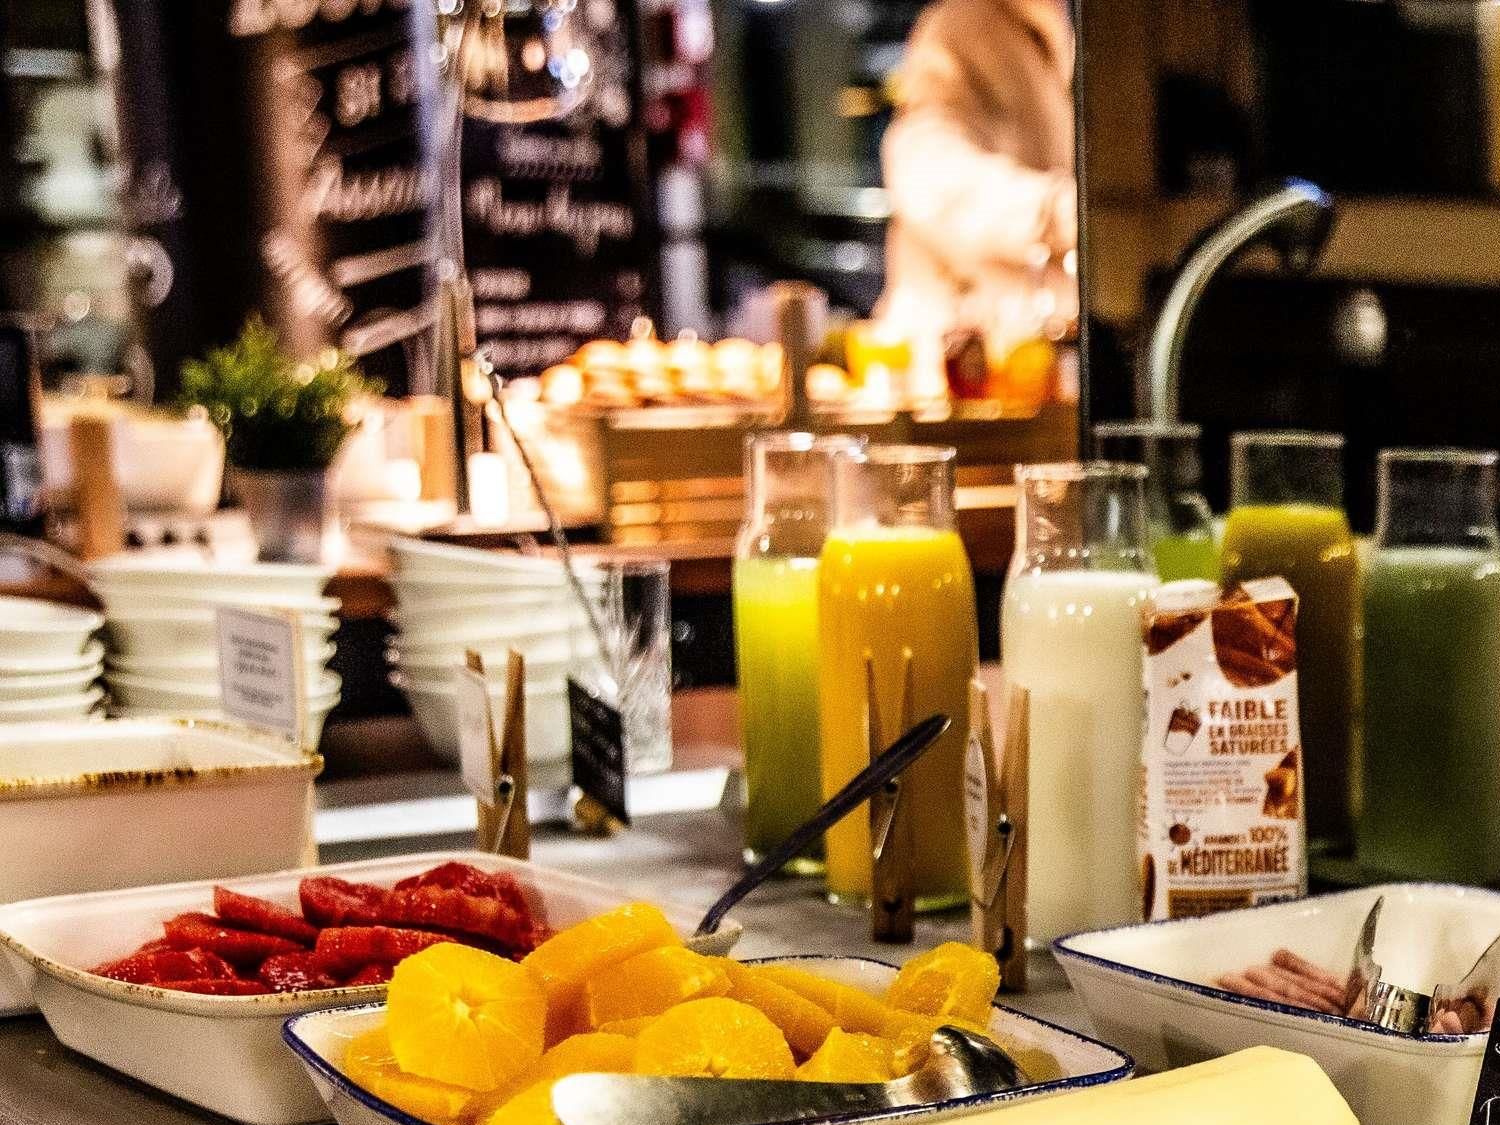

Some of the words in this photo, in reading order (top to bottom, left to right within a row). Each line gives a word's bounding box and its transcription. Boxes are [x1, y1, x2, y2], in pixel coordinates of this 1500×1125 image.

[1208, 698, 1288, 720] FAIBLE
[1250, 825, 1288, 843] 100%
[1180, 845, 1289, 876] MÉDITERRANÉE
